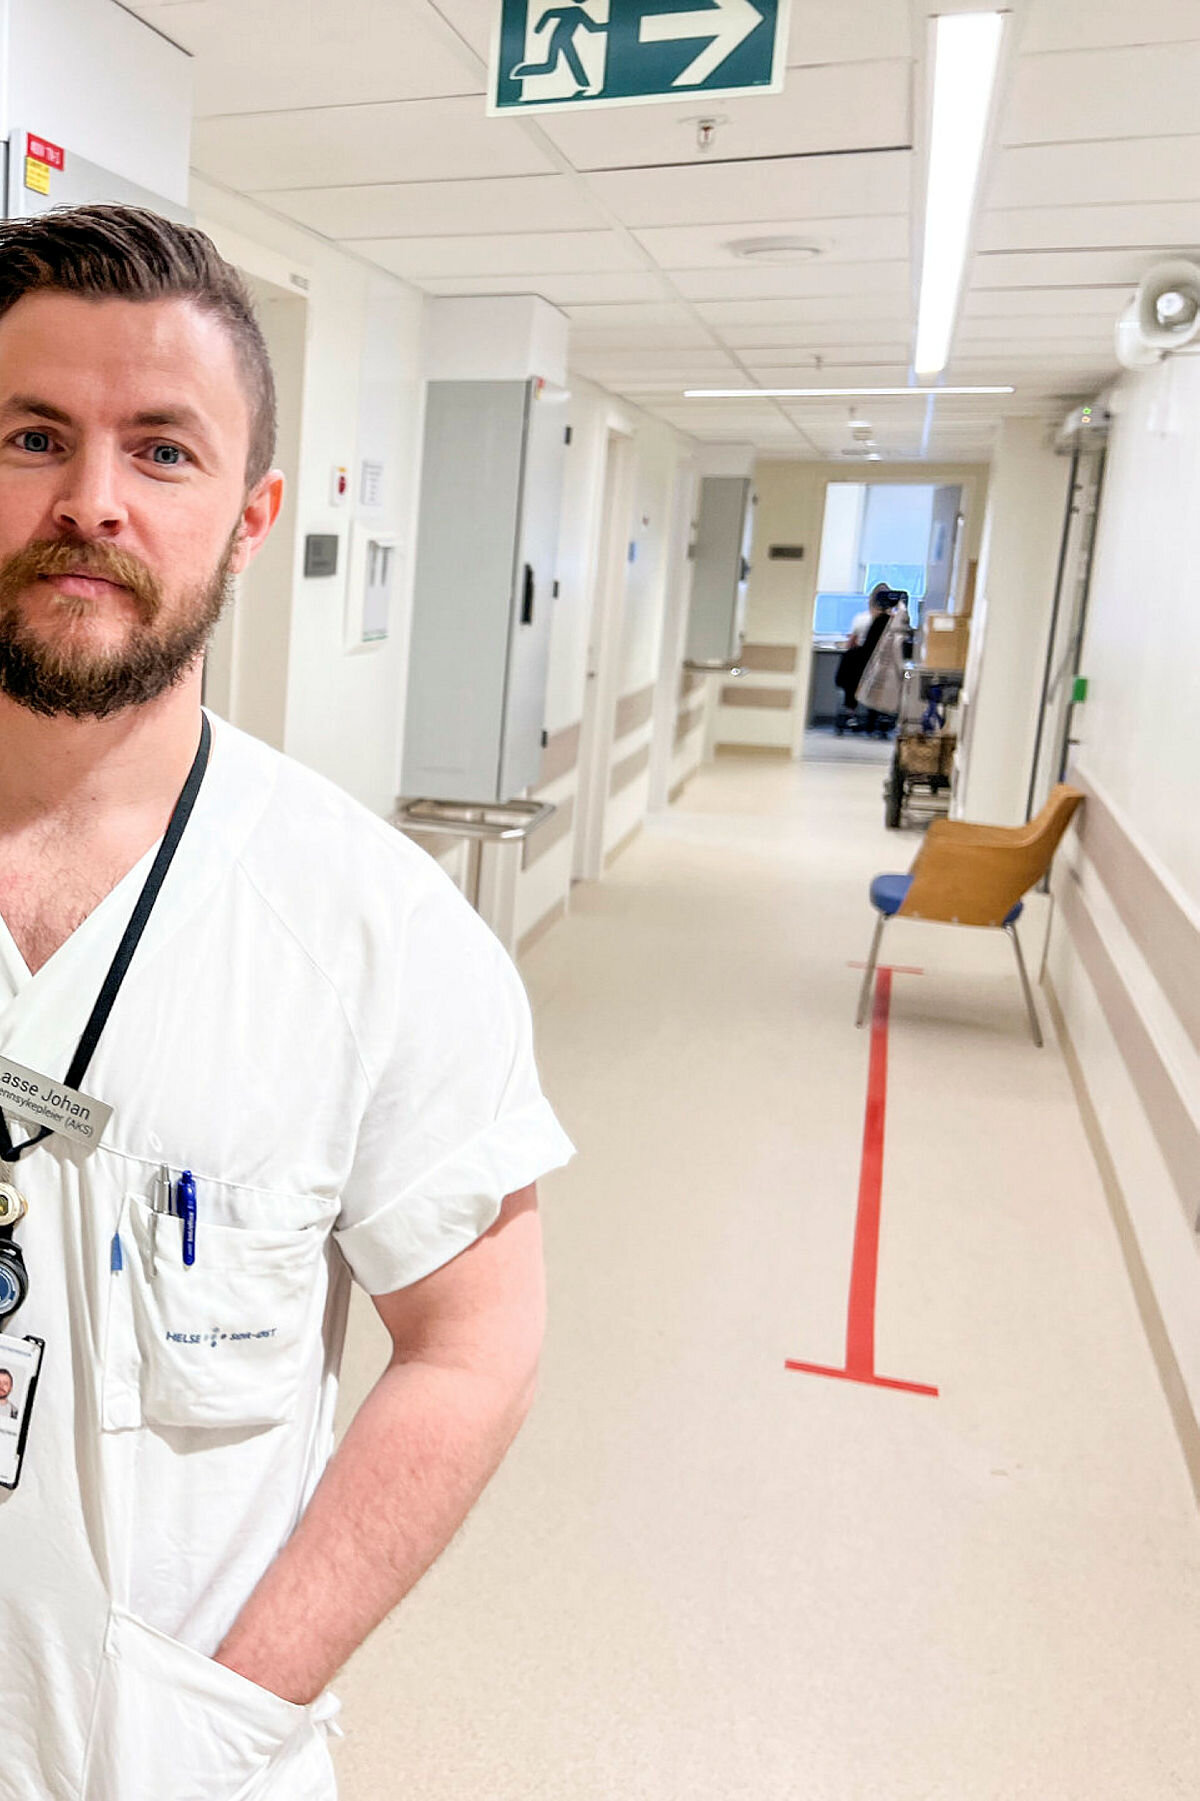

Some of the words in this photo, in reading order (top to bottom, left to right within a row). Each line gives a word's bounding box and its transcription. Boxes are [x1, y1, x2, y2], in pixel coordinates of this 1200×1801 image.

[41, 1089, 90, 1120] Johan
[65, 1117, 94, 1138] (AKS)
[166, 1331, 201, 1344] HELSE
